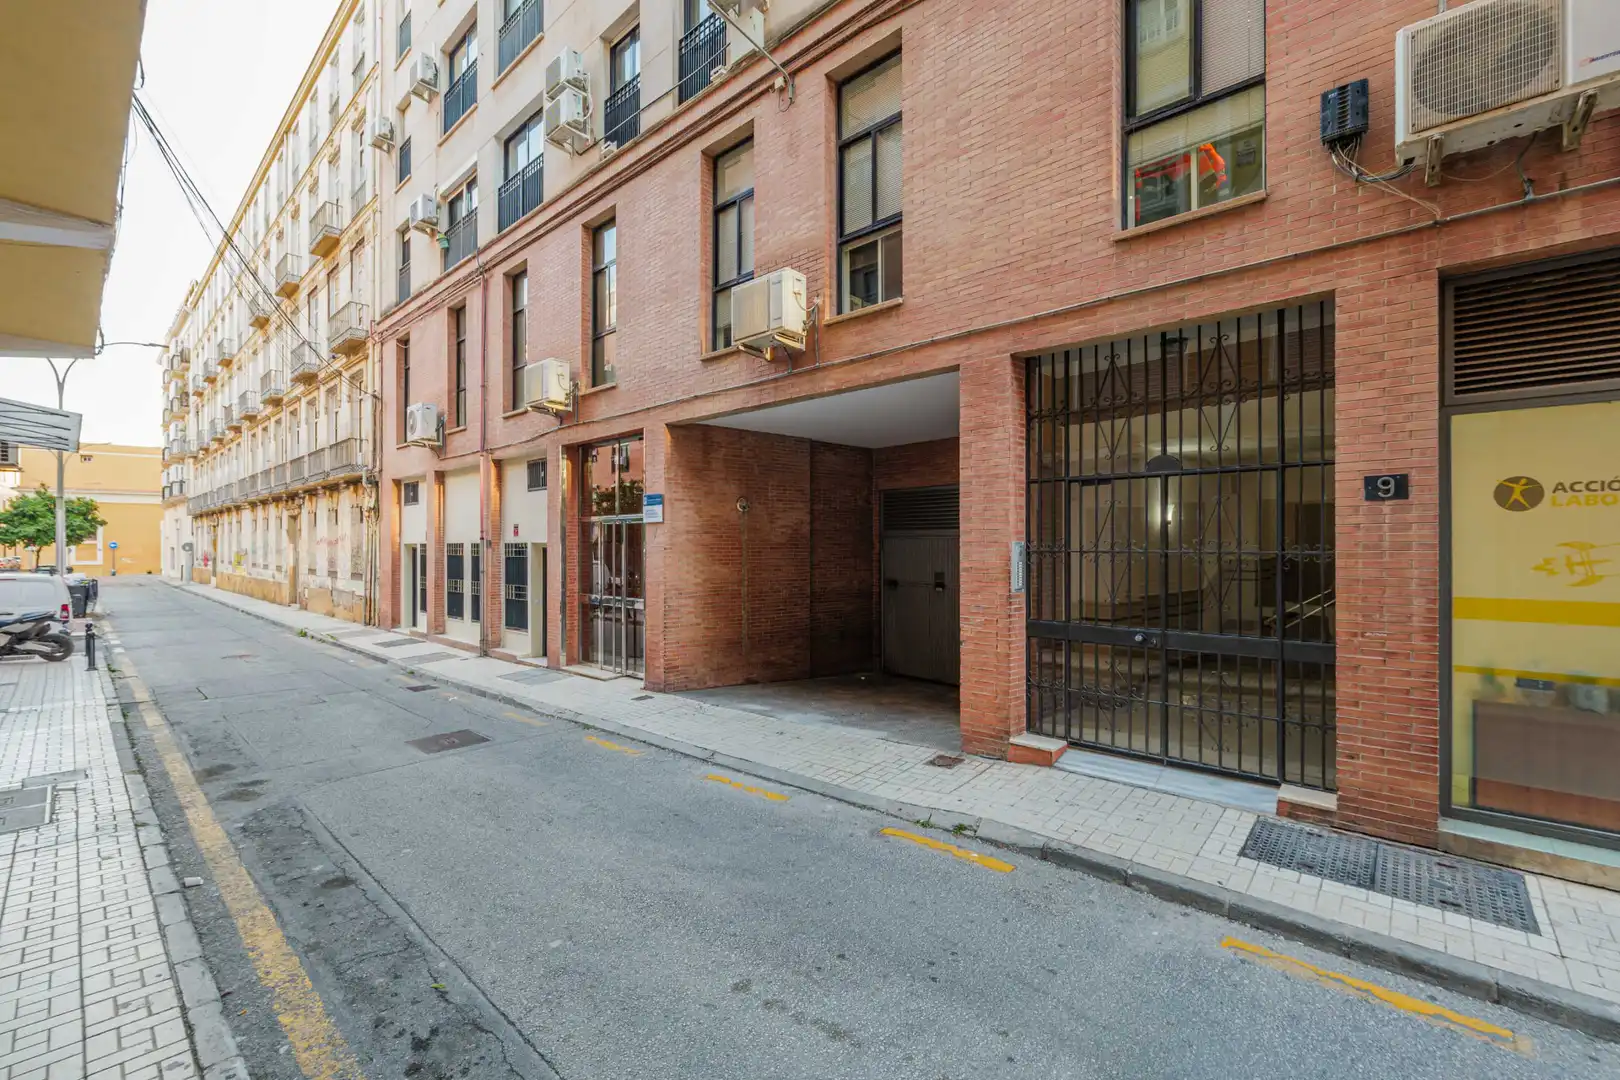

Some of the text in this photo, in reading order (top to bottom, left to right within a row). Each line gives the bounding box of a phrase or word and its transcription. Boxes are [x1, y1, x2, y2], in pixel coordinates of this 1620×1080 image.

[1377, 476, 1395, 498] 9
[1552, 475, 1620, 494] ACCIÓ
[1551, 493, 1619, 507] LABO
